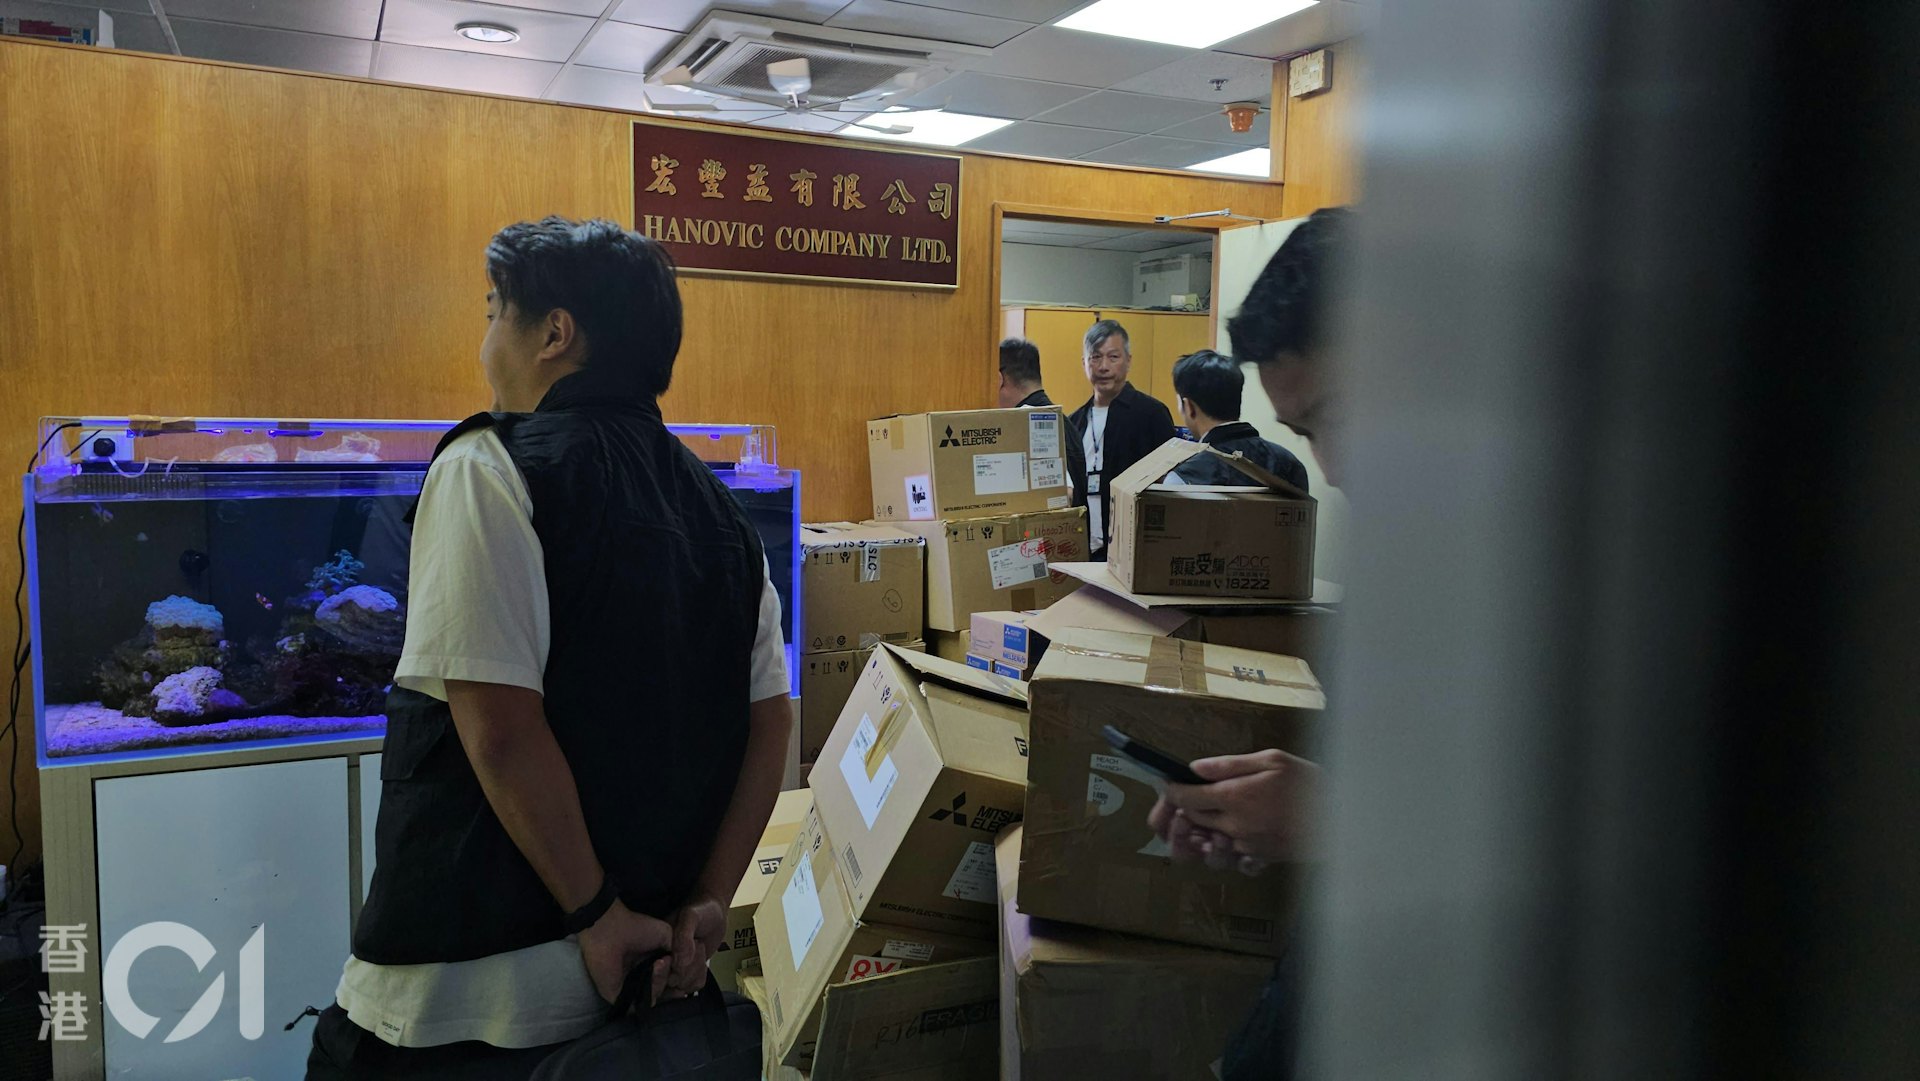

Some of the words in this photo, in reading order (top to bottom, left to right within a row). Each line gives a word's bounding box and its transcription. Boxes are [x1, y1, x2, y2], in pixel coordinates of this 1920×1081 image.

[645, 153, 952, 220] 宏豐益有限公司
[643, 214, 764, 249] HANOVIC
[775, 226, 892, 259] COMPANY
[902, 236, 951, 264] LTD.
[961, 427, 1002, 438] MITSUBISHI
[962, 436, 997, 447] ELECTRIC
[1226, 554, 1270, 568] ADCC
[1226, 578, 1270, 590] 18222
